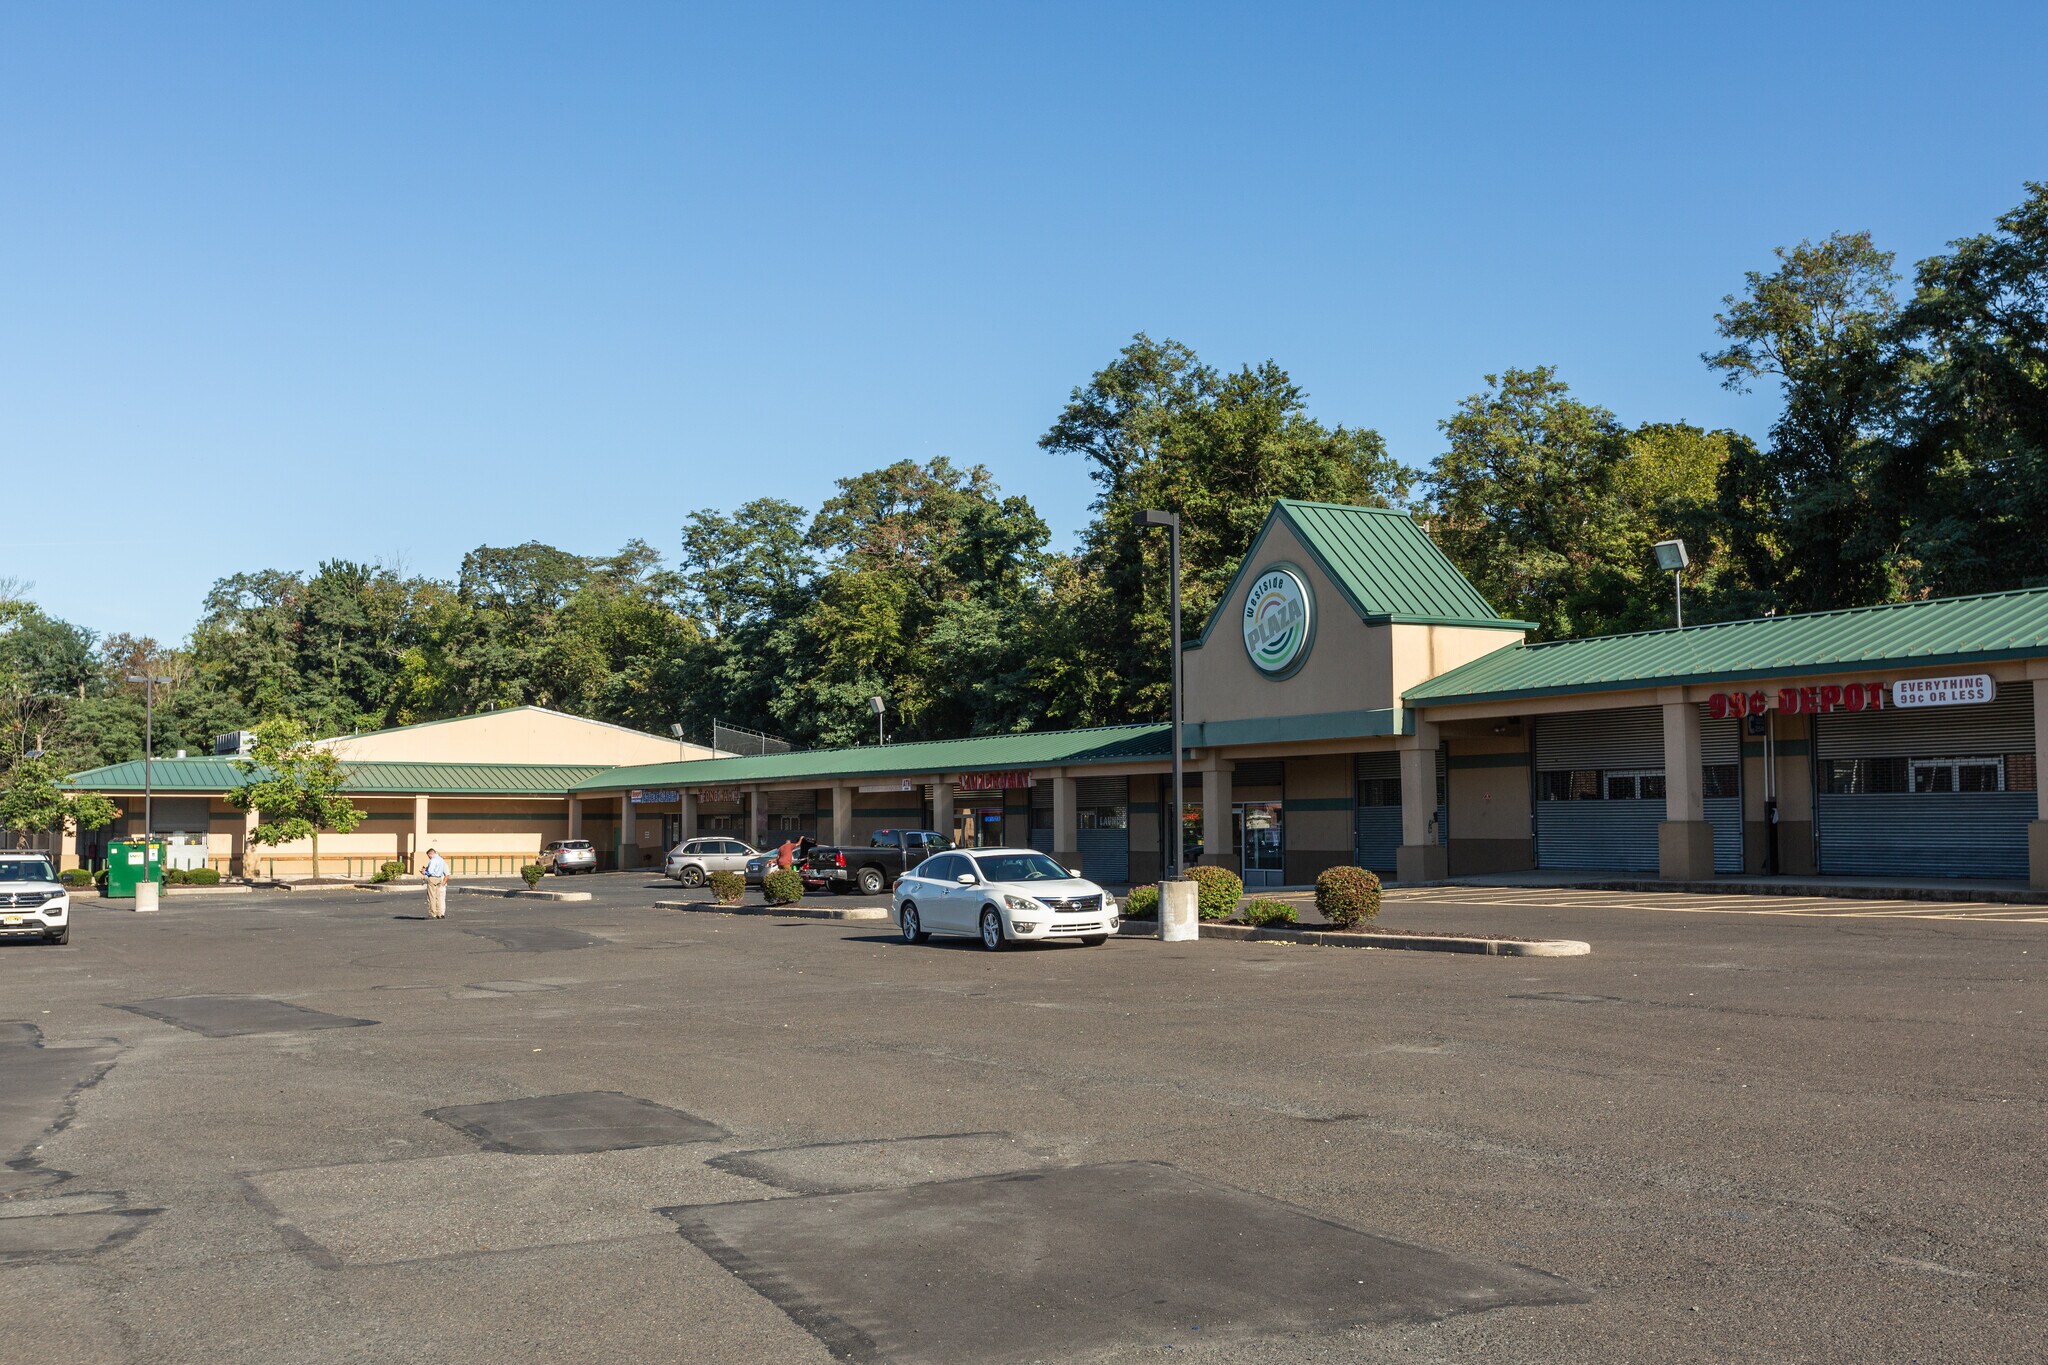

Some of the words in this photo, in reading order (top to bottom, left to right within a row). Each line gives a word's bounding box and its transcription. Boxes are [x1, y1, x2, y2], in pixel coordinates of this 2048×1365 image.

[1247, 598, 1302, 652] PLAZA
[1900, 677, 1984, 693] EVERYTHING
[1900, 693, 1925, 704] 99¢
[1929, 691, 1946, 702] OR
[1951, 689, 1985, 701] LESS
[1708, 690, 1768, 719] 99¢
[1778, 682, 1886, 715] DEPOT
